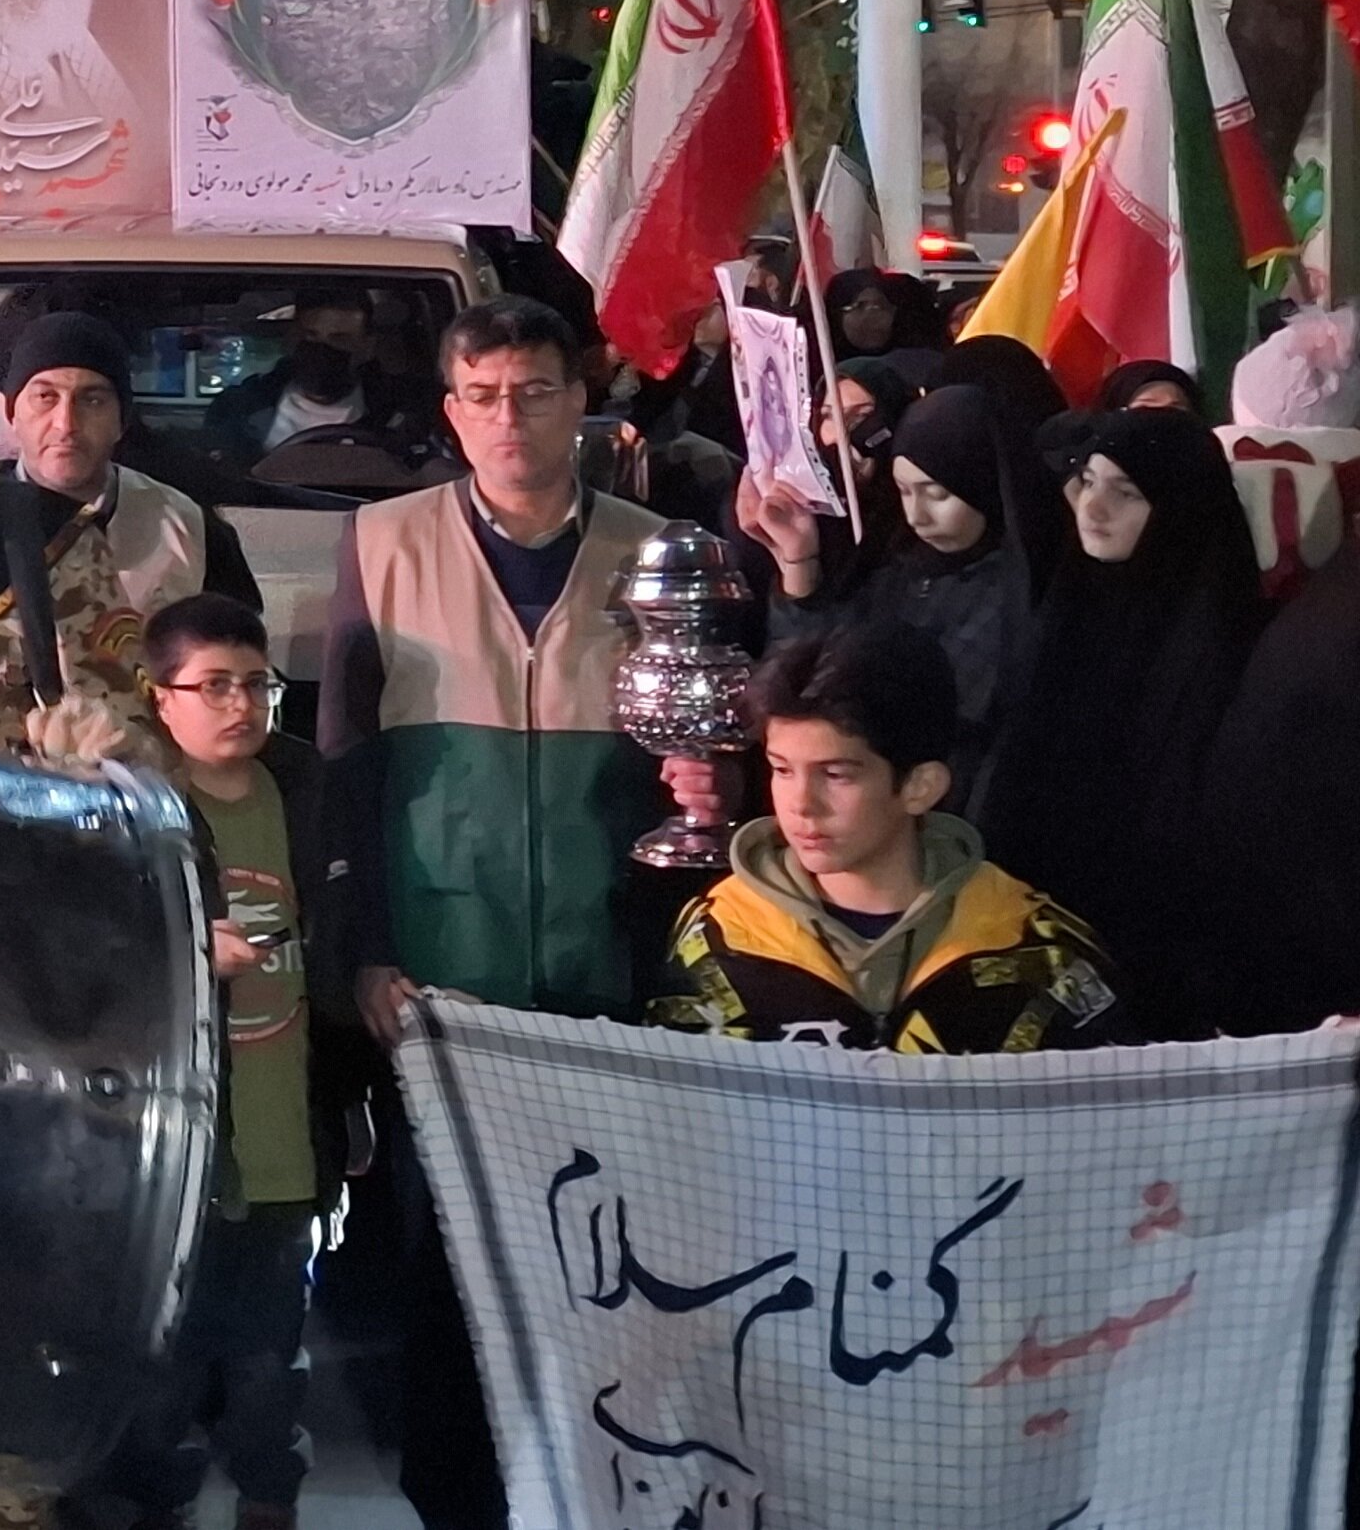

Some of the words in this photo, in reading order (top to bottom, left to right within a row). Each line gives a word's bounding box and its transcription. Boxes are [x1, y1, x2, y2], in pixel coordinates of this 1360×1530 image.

[0, 77, 103, 137] علی
[245, 171, 292, 198] مولوی
[292, 172, 313, 193] محمد
[314, 166, 347, 206] شهید
[470, 173, 522, 200] مهندس
[547, 1147, 798, 1312] سلام
[735, 1176, 1025, 1430] گمنام
[972, 1180, 1197, 1437] شهید
